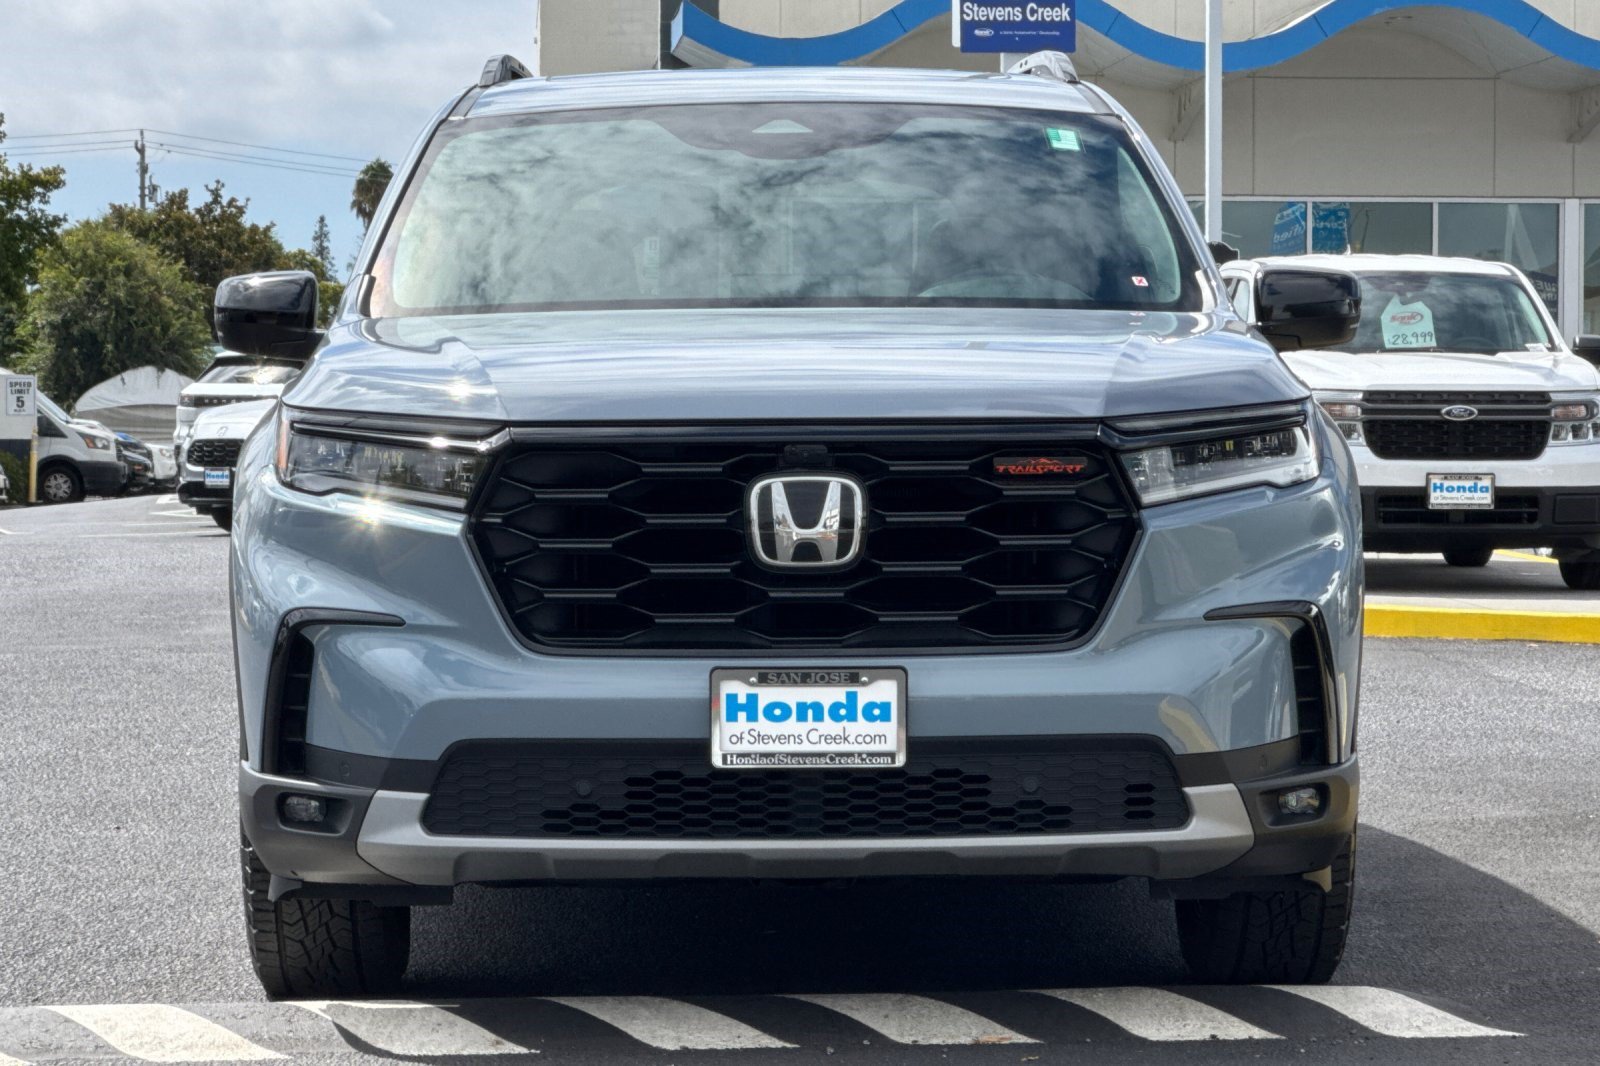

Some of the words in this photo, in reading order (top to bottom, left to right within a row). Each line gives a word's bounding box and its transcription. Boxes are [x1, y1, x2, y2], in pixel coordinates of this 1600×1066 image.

[963, 2, 1022, 21] Stevens
[1026, 2, 1071, 21] Creek
[16, 396, 25, 408] 5
[994, 464, 1085, 474] TRAILSPORT
[1432, 482, 1490, 493] Honda
[767, 672, 801, 683] SAN
[806, 672, 850, 683] JOSE
[725, 691, 892, 723] Honda
[729, 731, 745, 745] of
[747, 728, 804, 745] Stevens
[806, 726, 887, 745] Creek.com
[726, 753, 892, 765] HondaofStevensCreek.com
